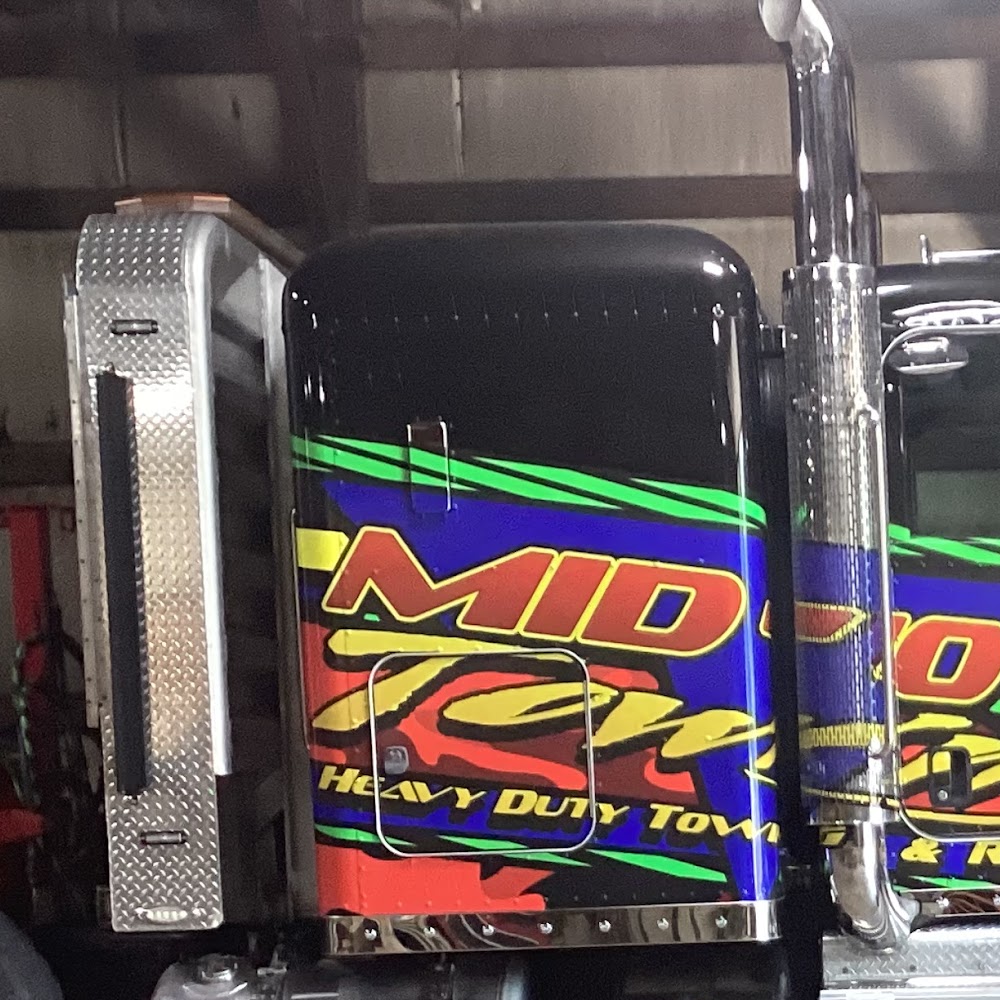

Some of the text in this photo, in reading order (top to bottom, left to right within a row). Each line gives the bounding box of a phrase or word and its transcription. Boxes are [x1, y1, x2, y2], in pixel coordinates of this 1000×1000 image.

[322, 526, 748, 657] MID
[493, 789, 630, 827] DUTY
[900, 836, 944, 863] &
